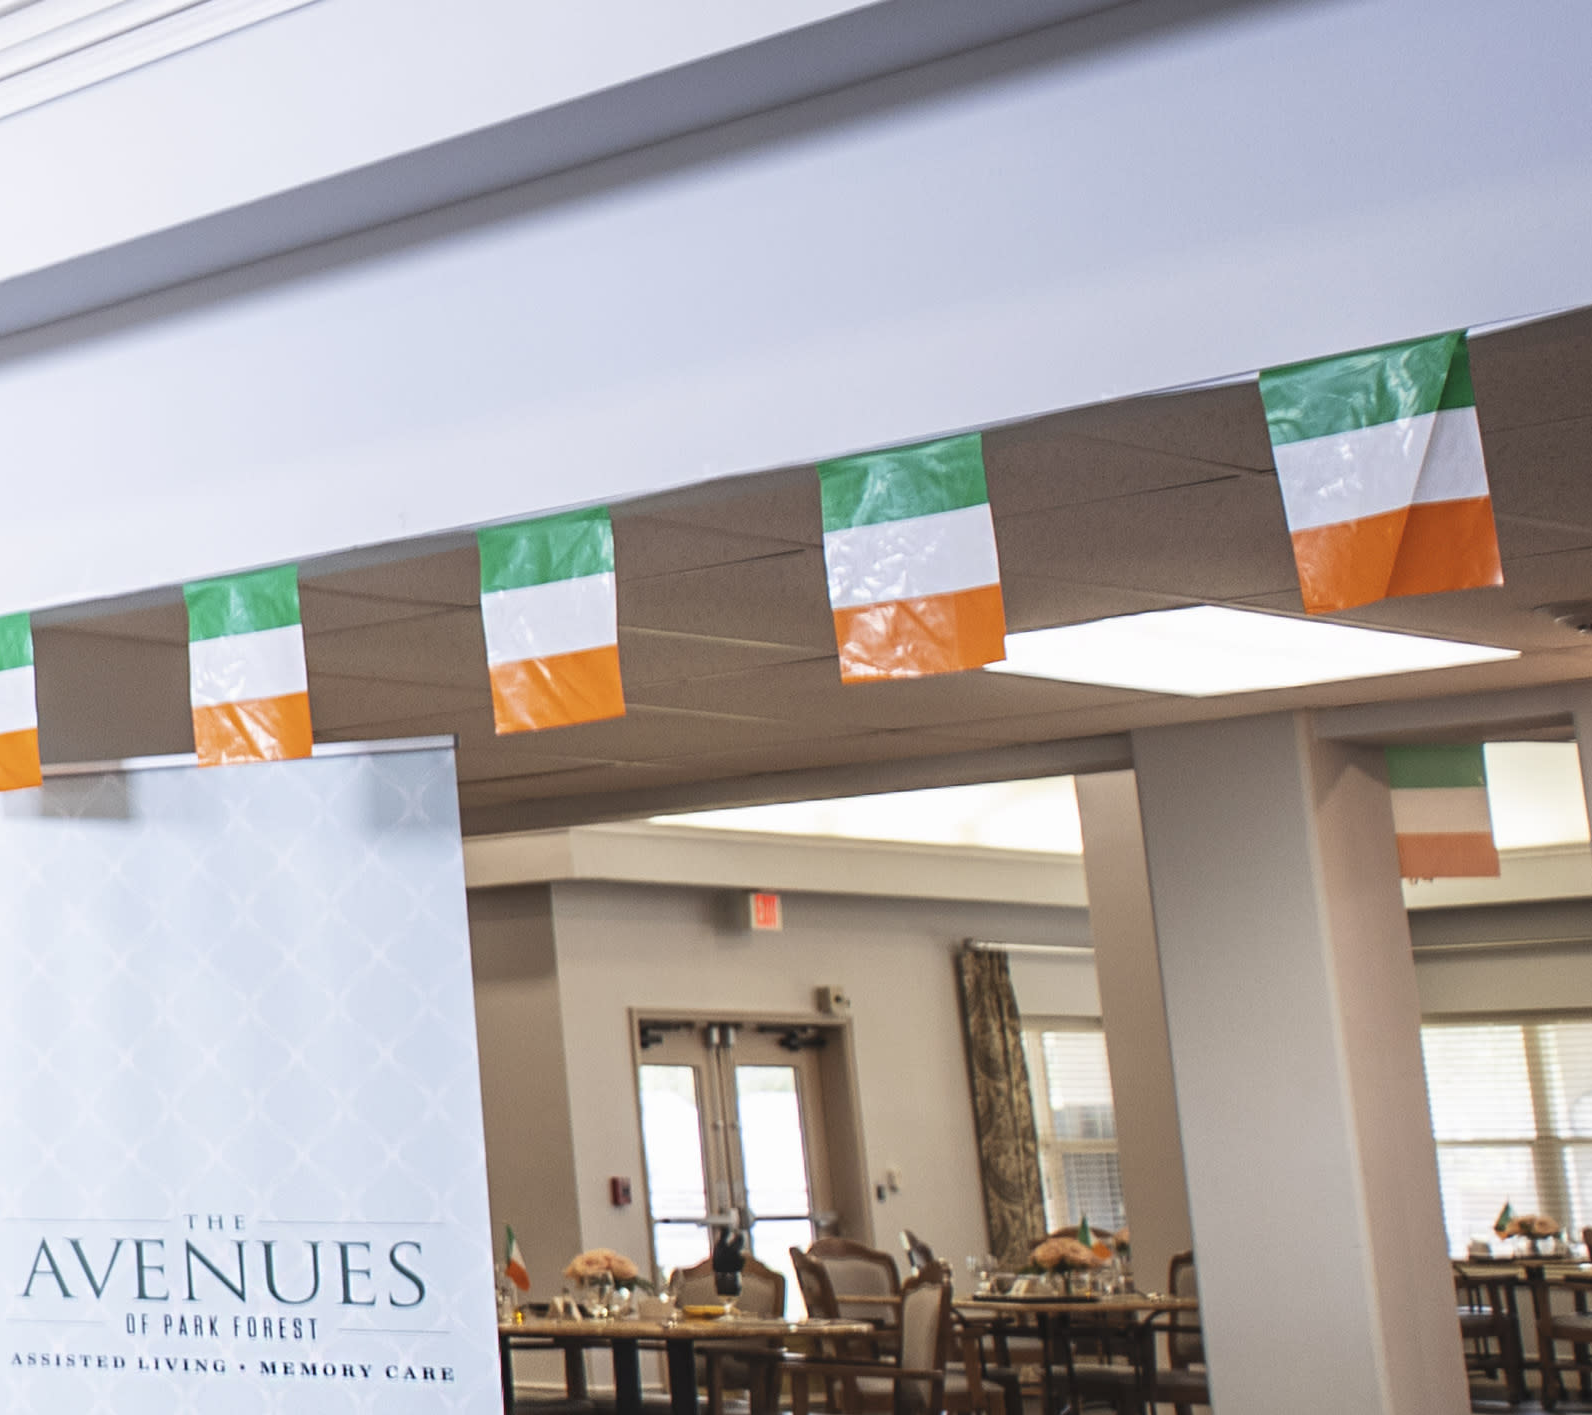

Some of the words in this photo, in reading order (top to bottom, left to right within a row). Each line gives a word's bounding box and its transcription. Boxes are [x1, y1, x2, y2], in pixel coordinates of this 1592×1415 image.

[183, 1213, 246, 1232] THE
[18, 1236, 426, 1308] AVENUES
[125, 1312, 149, 1337] OF
[163, 1313, 220, 1338] PARK
[233, 1315, 318, 1341] FOREST
[11, 1352, 126, 1370] ASSISTED
[137, 1356, 226, 1375] LIVING
[259, 1360, 372, 1380] MEMORY
[384, 1365, 455, 1383] CARE
